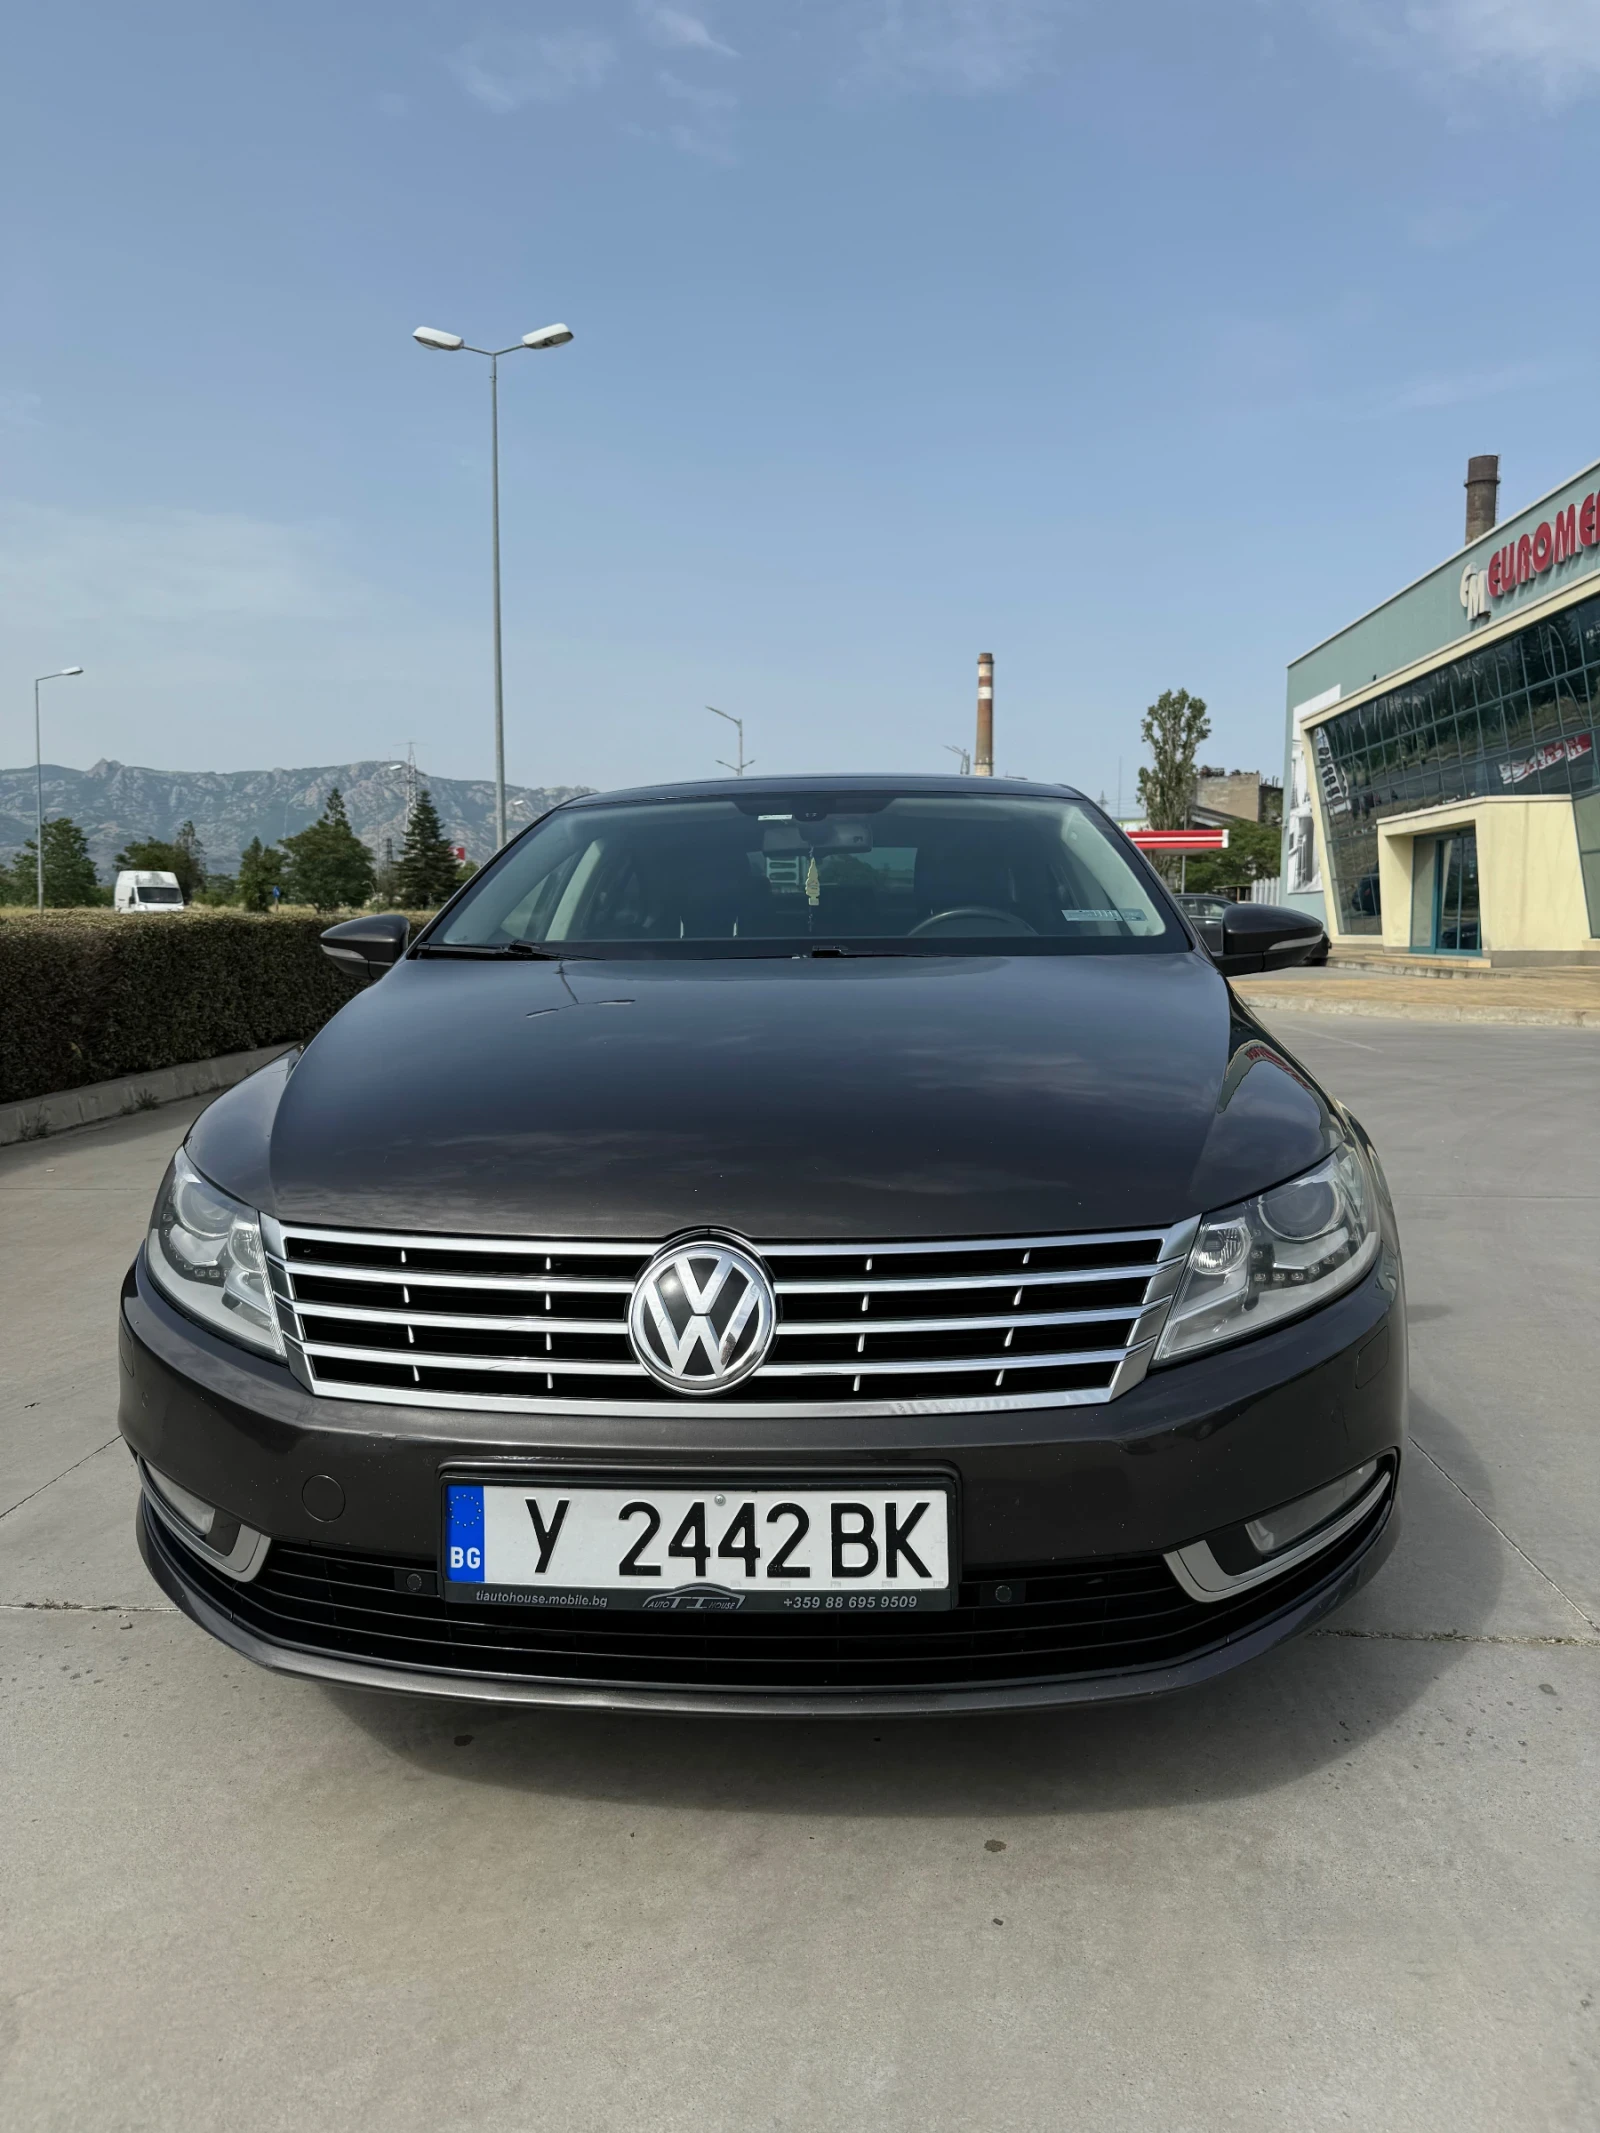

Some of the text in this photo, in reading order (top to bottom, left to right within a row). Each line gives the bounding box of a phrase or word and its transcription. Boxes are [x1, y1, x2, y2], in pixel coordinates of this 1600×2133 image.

[1487, 490, 1600, 598] EUROME
[618, 1501, 811, 1578] 2442
[831, 1502, 933, 1578] BK
[450, 1546, 481, 1569] BG
[476, 1590, 608, 1607] tiautohouse.mobile.bg
[708, 1601, 736, 1609] HOUSE
[783, 1595, 918, 1609] +359 88 695 9509
